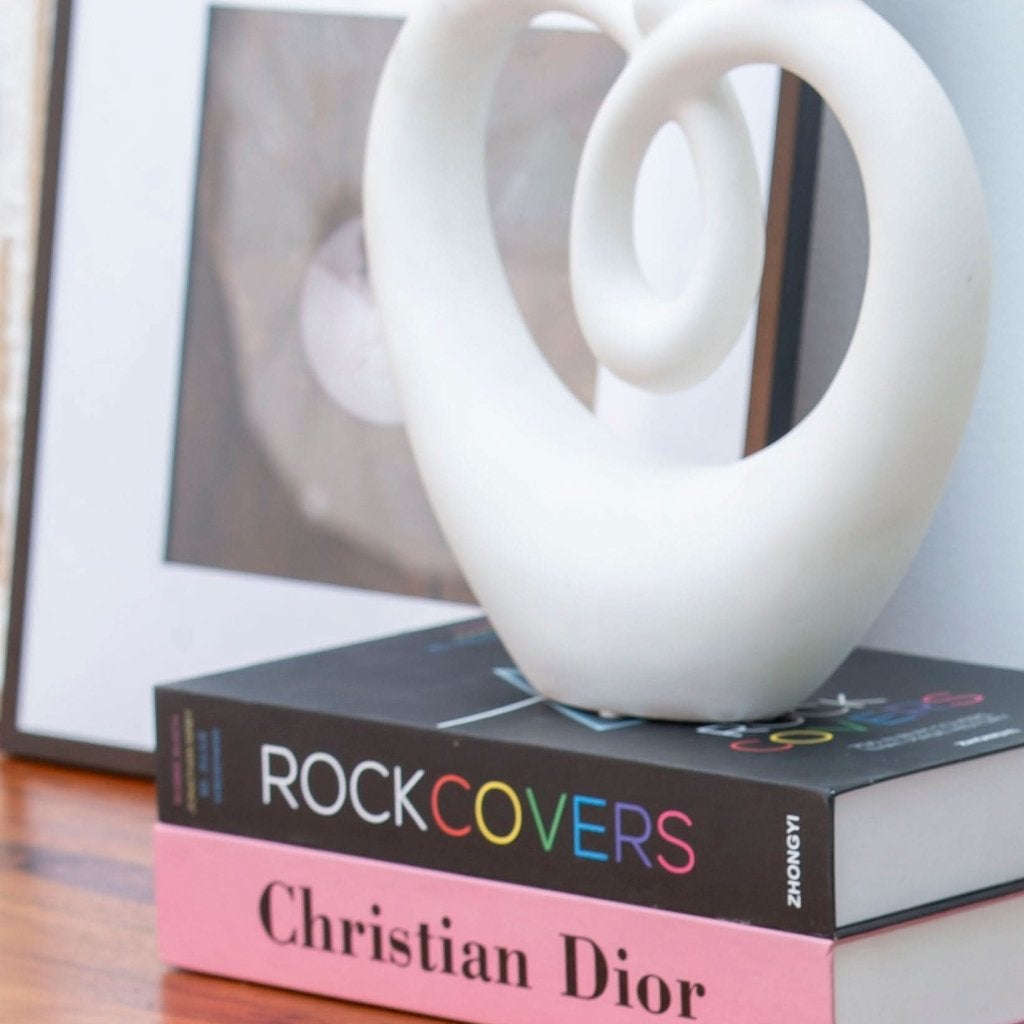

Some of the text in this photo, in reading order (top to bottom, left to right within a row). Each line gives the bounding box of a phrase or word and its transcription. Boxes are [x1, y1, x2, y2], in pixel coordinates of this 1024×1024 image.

[785, 813, 802, 909] ZHONGYI
[257, 879, 707, 1021] Christian Dior
